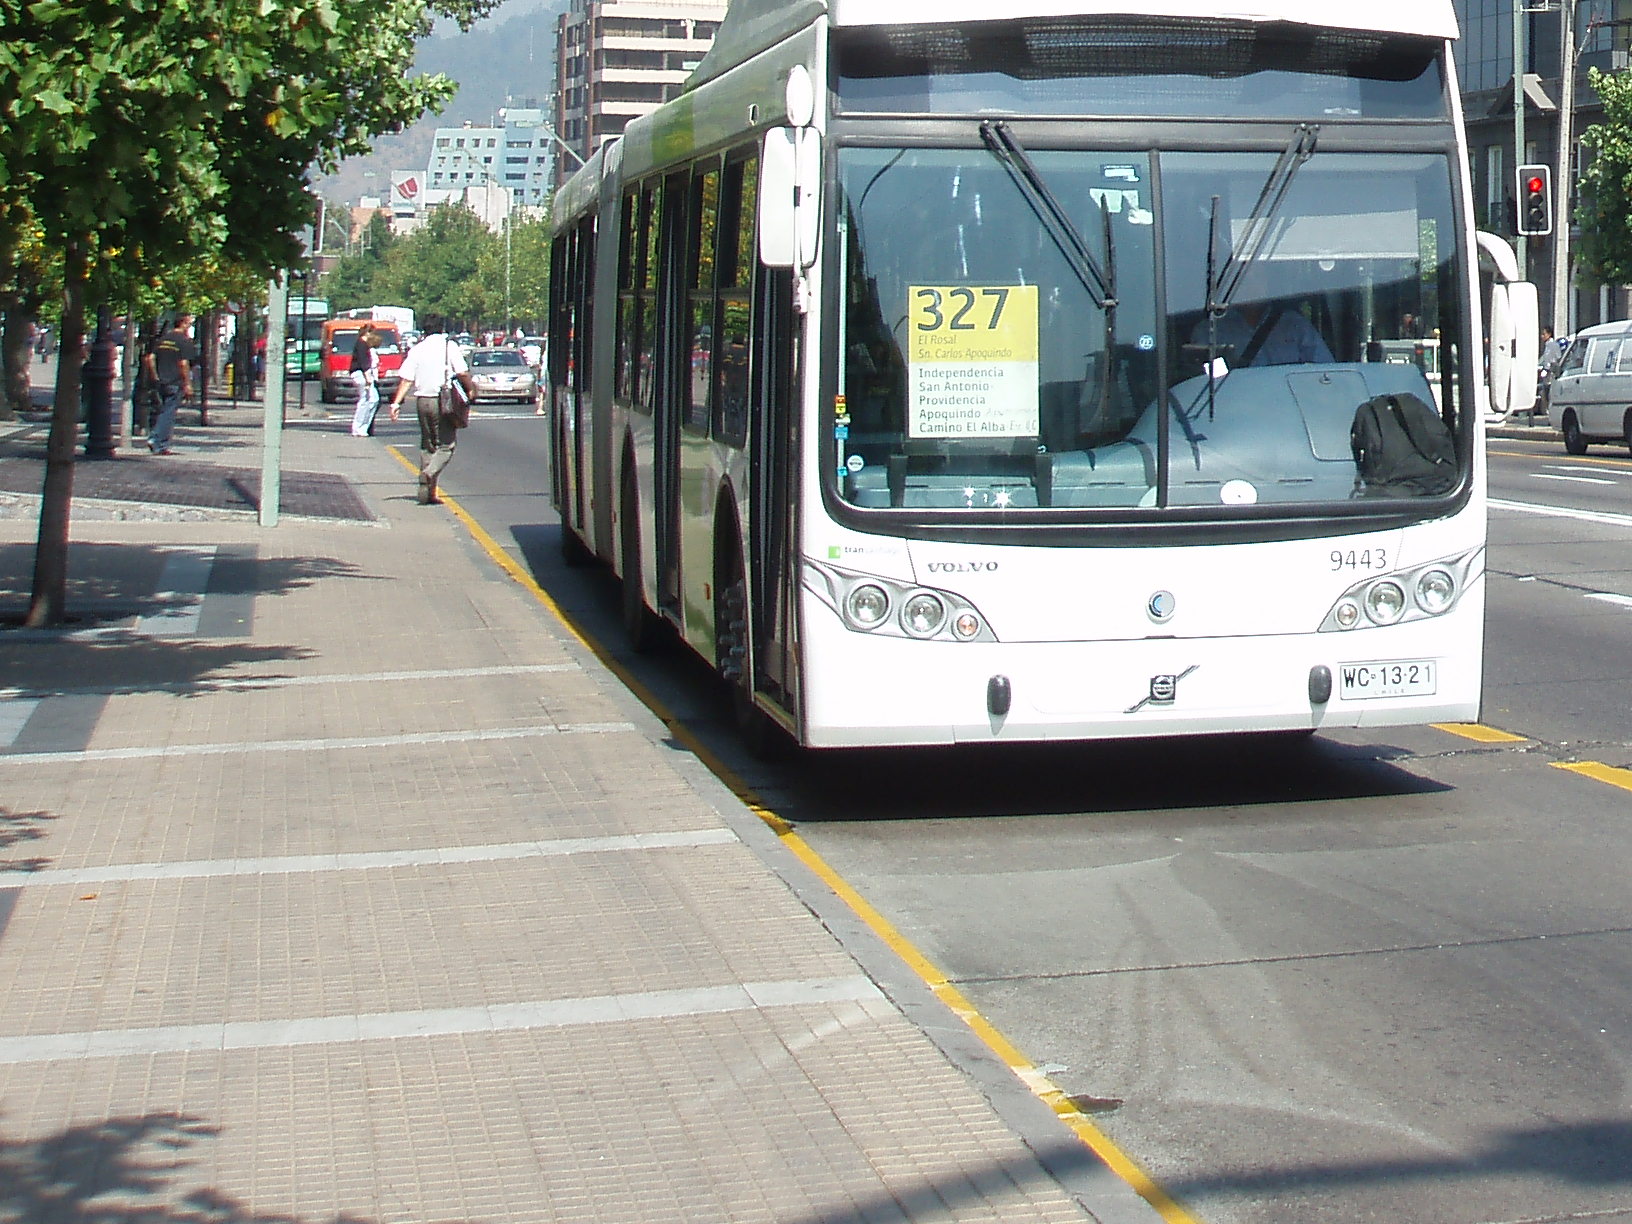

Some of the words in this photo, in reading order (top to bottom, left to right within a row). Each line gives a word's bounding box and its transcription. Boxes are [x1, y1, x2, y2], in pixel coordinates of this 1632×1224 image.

[917, 287, 1010, 331] 327
[918, 335, 928, 345] El
[930, 334, 957, 345] Rosal
[935, 349, 963, 359] Carlos
[965, 347, 1013, 360] Apoquindo
[919, 367, 1004, 379] Independencia
[919, 381, 940, 392] San
[943, 380, 990, 392] Antonio
[919, 394, 986, 405] Providencia
[919, 408, 981, 421] Apoquindo
[919, 421, 962, 433] Camino
[966, 421, 977, 432] El
[980, 421, 1006, 432] Alba
[1330, 548, 1387, 572] 9443
[927, 561, 999, 573] VOLVO
